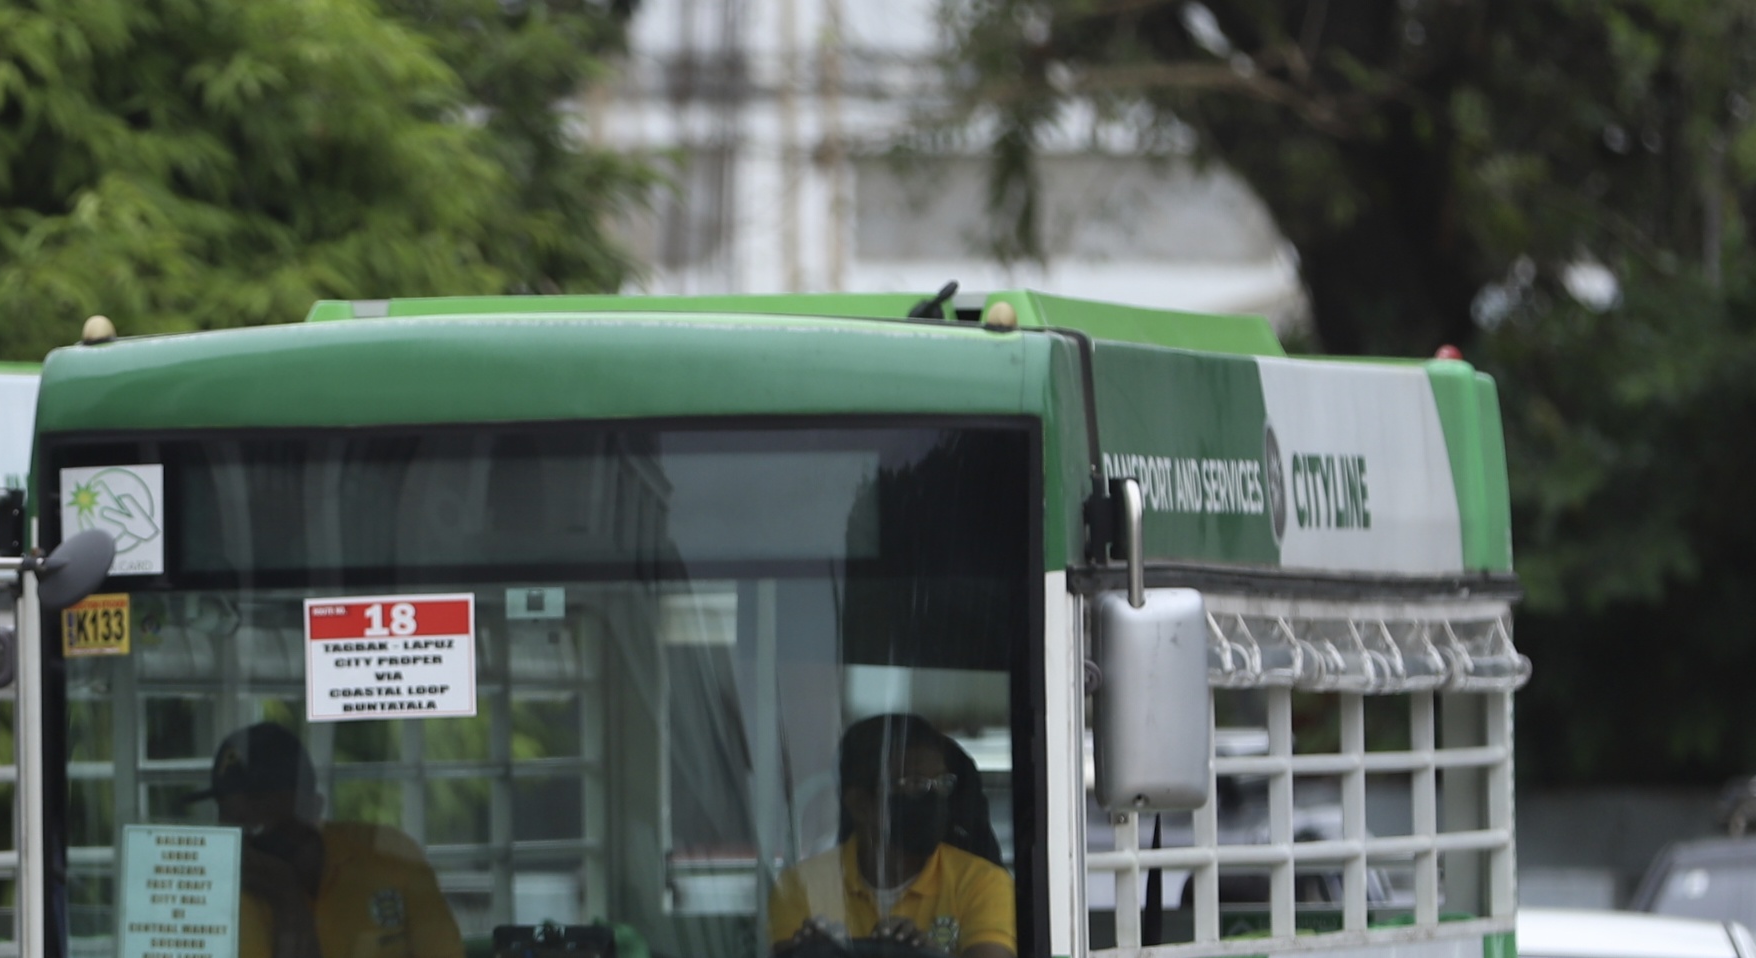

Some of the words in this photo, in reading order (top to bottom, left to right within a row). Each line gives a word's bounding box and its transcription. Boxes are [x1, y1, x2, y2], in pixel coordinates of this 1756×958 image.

[1173, 457, 1202, 513] AND
[1200, 457, 1264, 515] SERVICES
[1293, 452, 1371, 529] CITYLINE
[76, 609, 125, 642] K133
[363, 602, 418, 637] 18
[322, 641, 389, 654] TAGBAK
[403, 639, 455, 652] LAPUZ
[334, 656, 373, 669] CITY
[376, 655, 443, 668] PROPER
[374, 670, 404, 682] VIA
[329, 686, 402, 699] COASTAL
[406, 684, 450, 697] LOOP
[342, 699, 438, 713] BUNTATALA
